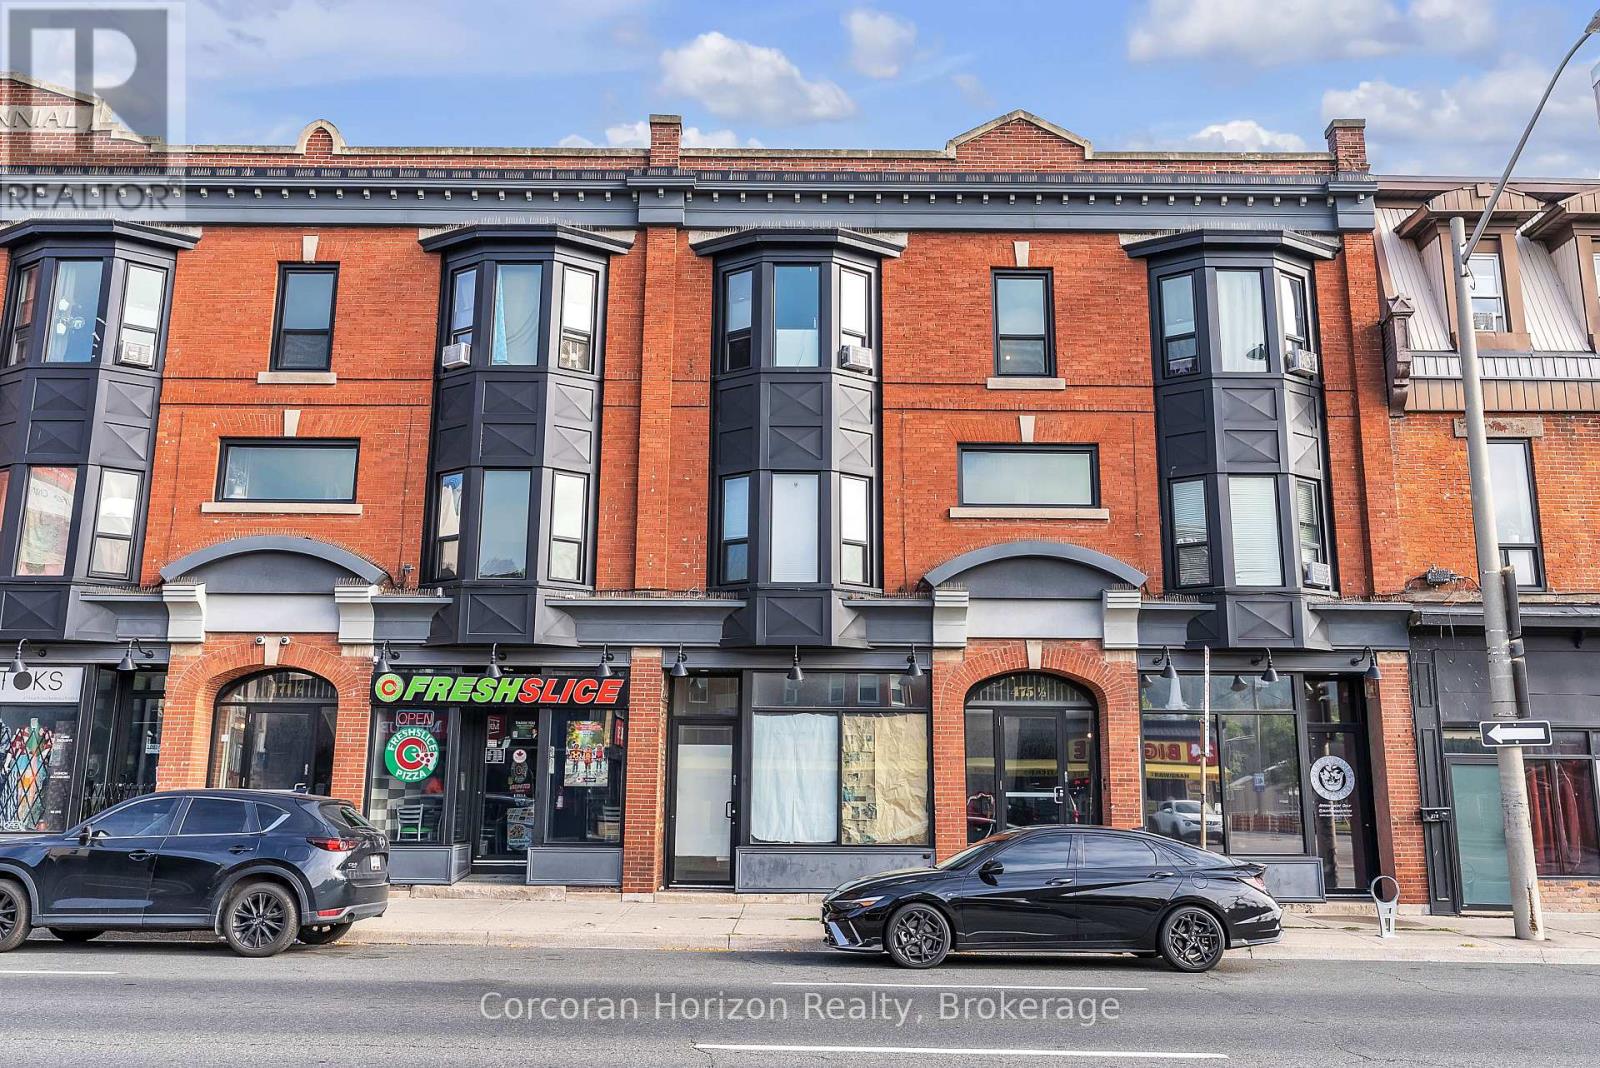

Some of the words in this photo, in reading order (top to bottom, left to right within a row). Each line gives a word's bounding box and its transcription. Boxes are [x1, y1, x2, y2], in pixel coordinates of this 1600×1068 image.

[403, 675, 624, 704] FRESHSLICE
[398, 712, 433, 725] OPEN
[387, 728, 438, 751] FRESHSLICE
[395, 769, 427, 781] PIZZA
